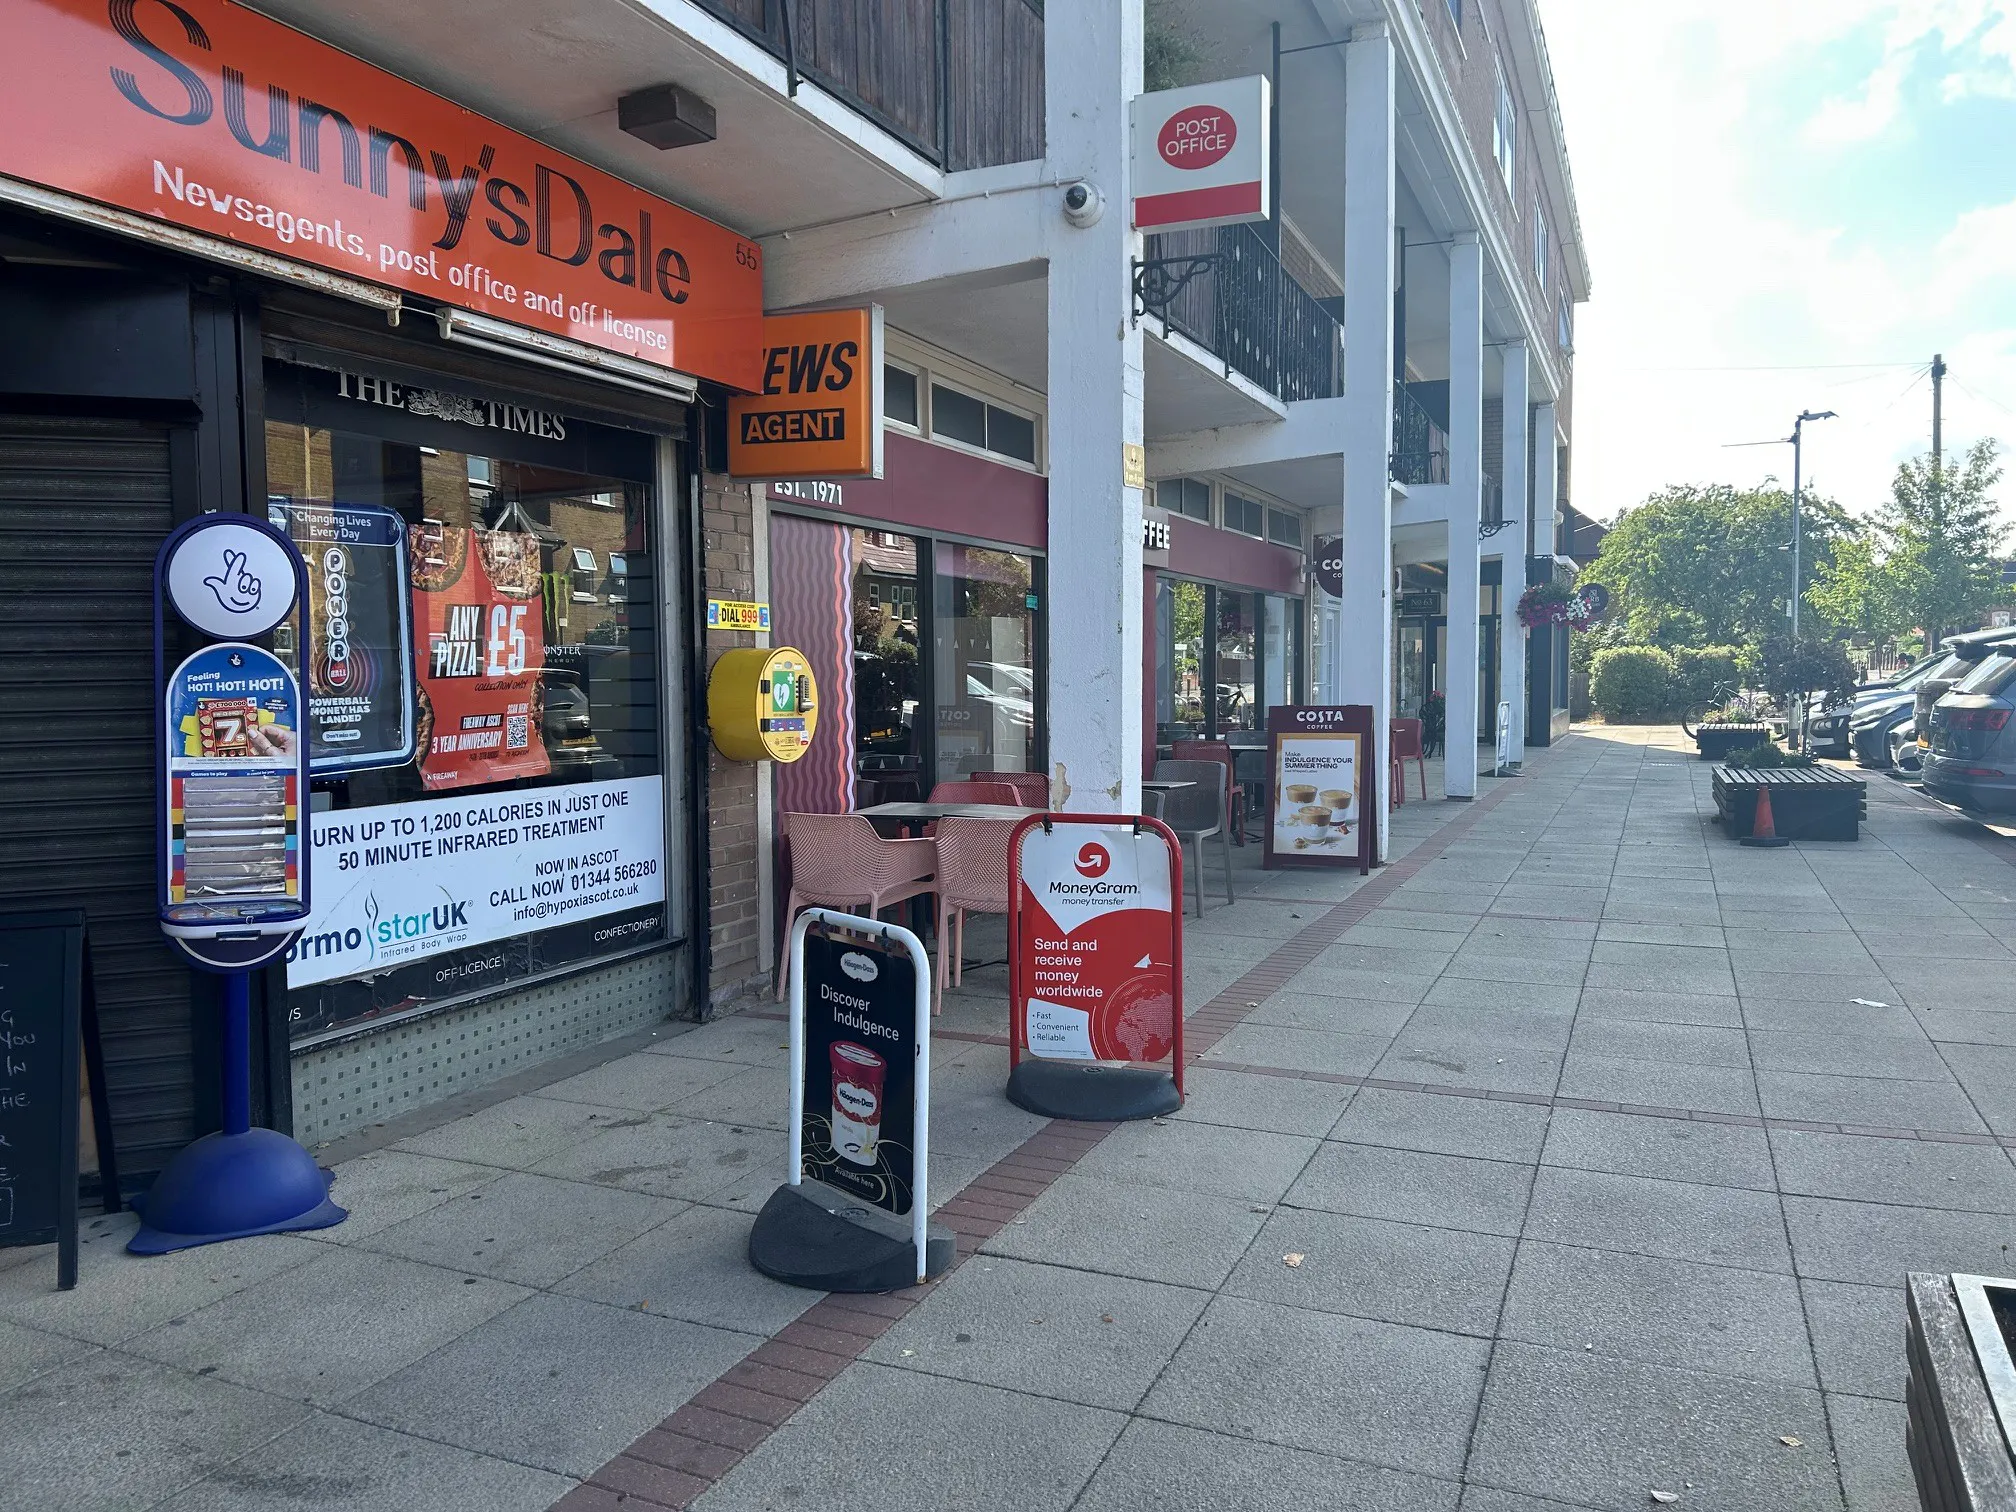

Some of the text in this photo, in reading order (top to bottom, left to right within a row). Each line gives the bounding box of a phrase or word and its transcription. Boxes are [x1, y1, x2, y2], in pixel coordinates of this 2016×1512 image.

[1176, 117, 1220, 137] POST
[1165, 133, 1227, 156] OFFICE
[153, 160, 667, 350] Newsagents, post office and off license
[736, 243, 757, 271] 55
[763, 341, 858, 395] EWS
[338, 367, 566, 441] THE TIMES
[746, 411, 840, 442] AGENT
[812, 481, 842, 505] 1971
[296, 511, 371, 528] Changing Lives
[310, 526, 360, 541] Every Day
[1142, 518, 1171, 549] FFEE
[330, 554, 345, 658] POWER
[721, 608, 757, 623] DIAL 999
[450, 606, 480, 640] ANY
[487, 605, 527, 677] £5
[543, 644, 581, 656] ONSTER
[435, 641, 478, 678] PIZZA
[187, 672, 220, 683] Feeling
[188, 678, 284, 692] HOT! HOT! HOT!
[308, 697, 371, 706] POWERBALL
[310, 705, 371, 716] MONEY HAS
[320, 714, 362, 724] LANDED
[1296, 710, 1344, 723] COSTA
[432, 731, 503, 754] 3 YEAR ANNIVERSARY
[310, 791, 629, 848] URN UP TO 1,200 CALORIES IN JUST ONE
[338, 815, 606, 872] 50 MINUTE INFRARED TREATMENT
[535, 849, 619, 877] NOW IN ASCOT
[490, 858, 657, 907] CALL NOW 01344 566280
[1049, 881, 1138, 897] MoneyGram
[513, 883, 640, 922] info@hypoxiascot.co.uk
[1062, 897, 1125, 906] money transfer
[594, 917, 659, 942] CONFECTIONERY
[286, 927, 362, 964] ormo
[380, 933, 467, 959] Infrared Body Wrap
[1034, 938, 1097, 951] Send and
[435, 957, 501, 982] OFF LICENCE
[1034, 953, 1082, 966] receive
[1034, 970, 1079, 984] money
[821, 983, 870, 1012] Discover
[1035, 985, 1103, 998] worldwide
[833, 1006, 900, 1041] Indulgence
[1036, 1012, 1051, 1020] Fast
[1036, 1023, 1079, 1031] Convenient
[1036, 1033, 1066, 1042] Reliable
[0, 1088, 31, 1108] HE
[834, 1165, 875, 1190] Available here
